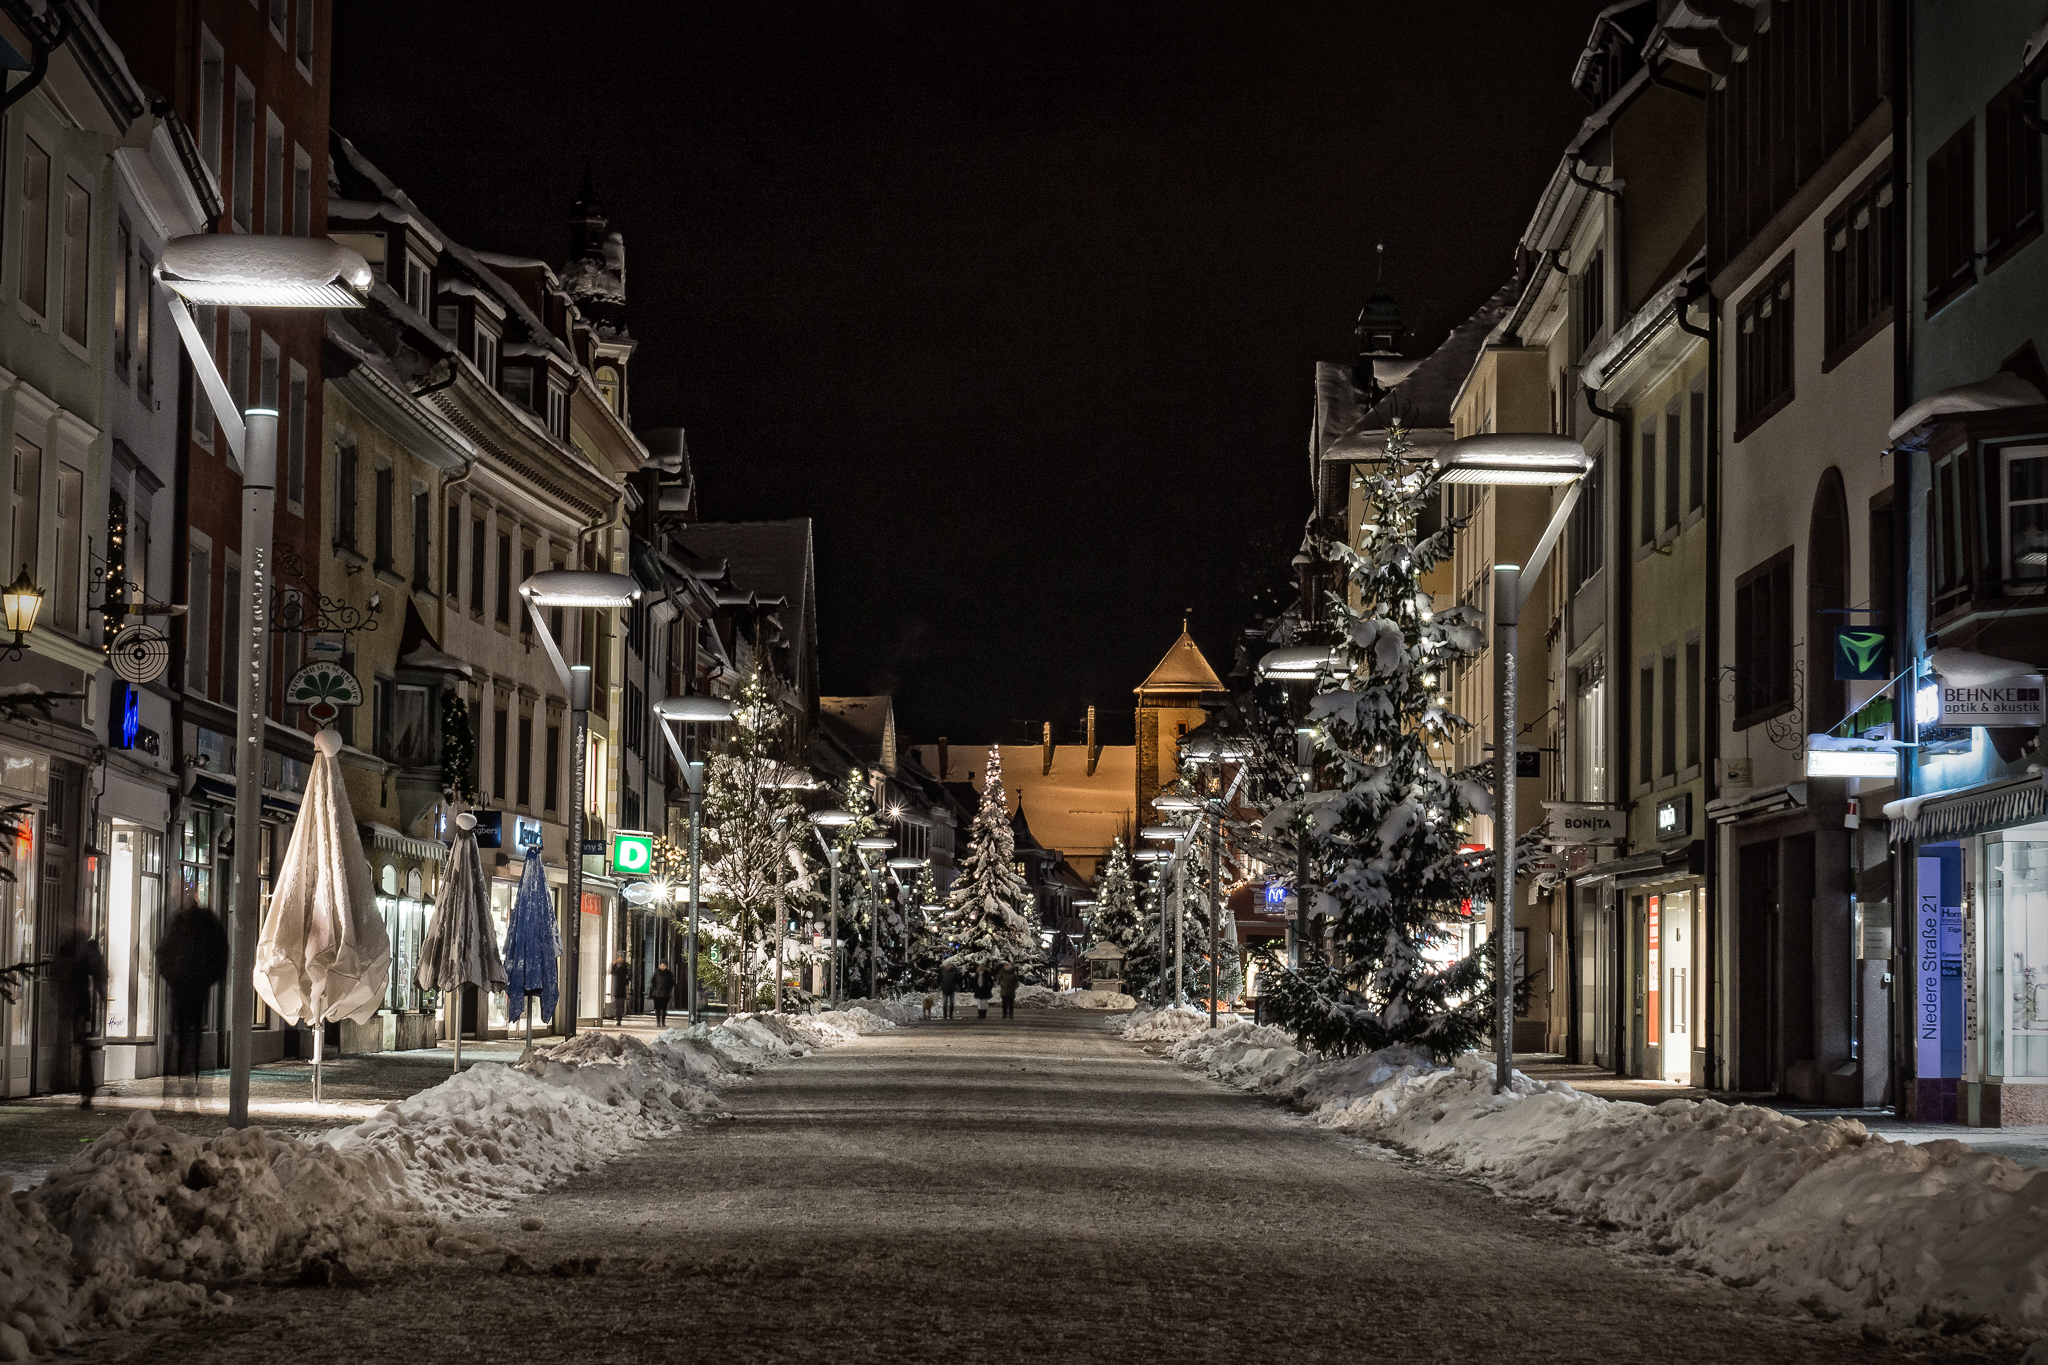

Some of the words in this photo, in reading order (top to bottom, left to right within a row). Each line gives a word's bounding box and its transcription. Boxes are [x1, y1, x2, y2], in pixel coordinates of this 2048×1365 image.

[289, 664, 331, 698] REFORMHAUS
[332, 665, 359, 701] SCHREMPP
[1944, 687, 2015, 702] BEHNKE
[1944, 702, 1977, 714] optik
[1981, 702, 1989, 712] &
[1993, 702, 2040, 712] akustik
[618, 840, 648, 870] D
[1922, 895, 1937, 913] 21
[1922, 918, 1937, 973] Straße
[1922, 977, 1937, 1040] Niedere
